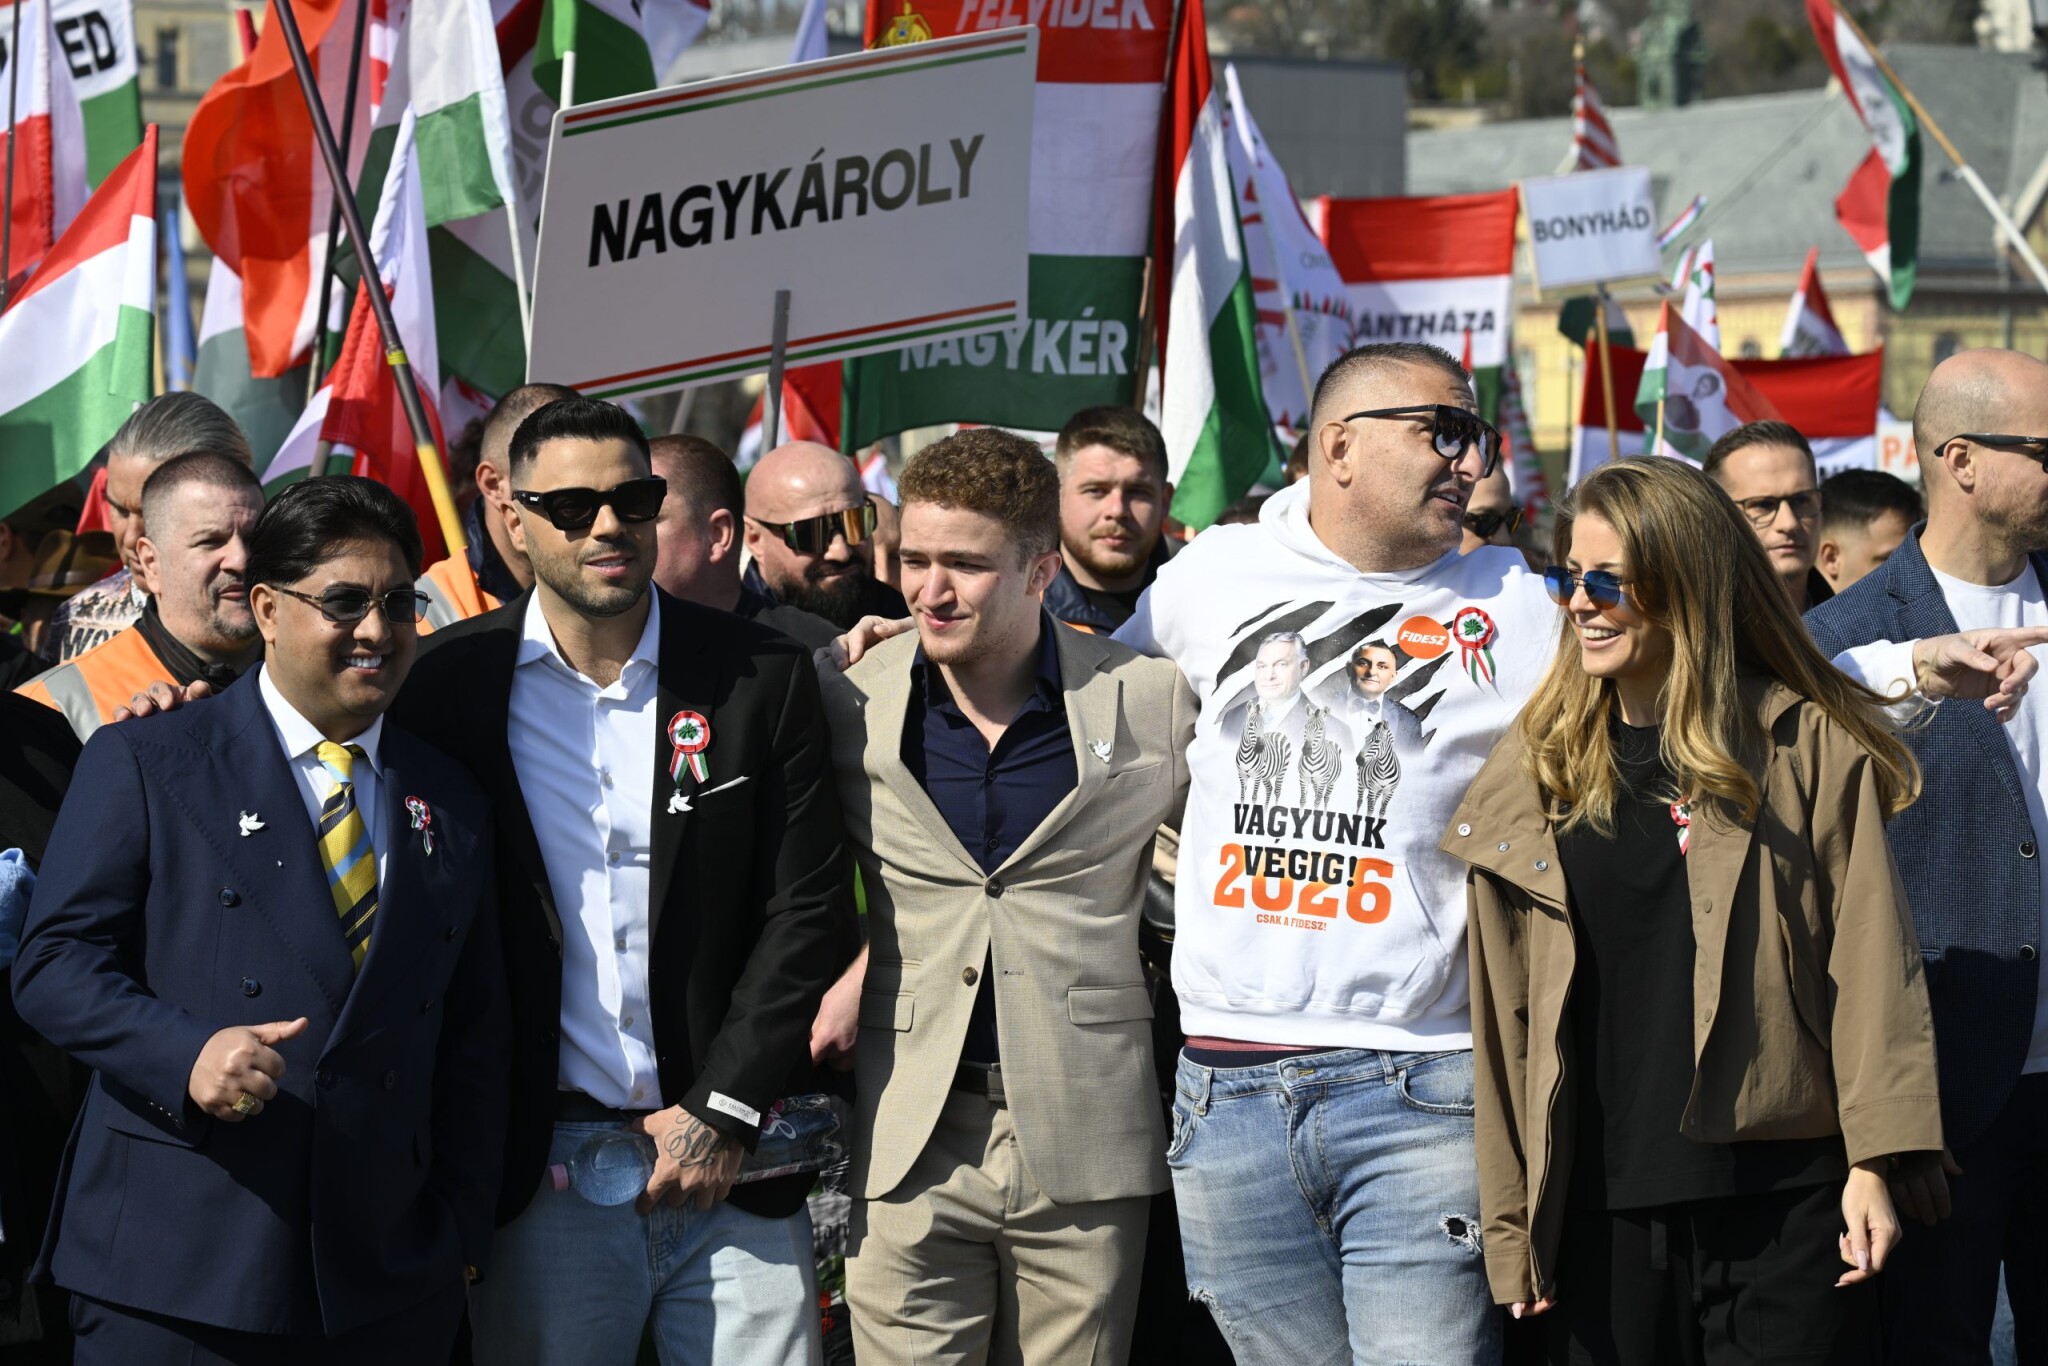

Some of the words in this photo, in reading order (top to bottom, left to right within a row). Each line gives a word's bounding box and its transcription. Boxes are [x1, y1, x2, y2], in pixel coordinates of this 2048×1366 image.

[588, 133, 985, 268] NAGYKÁROLY
[1533, 204, 1650, 242] BONYHÁD
[63, 625, 122, 660] WO
[1400, 630, 1447, 646] FIDESZ
[1234, 803, 1387, 849] VAGYUNK
[1213, 843, 1394, 924] 2026
[1244, 839, 1357, 887] VÉGIG!
[1256, 914, 1282, 925] CSAK
[1283, 916, 1289, 926] A
[1291, 917, 1327, 931] FIDESZ!
